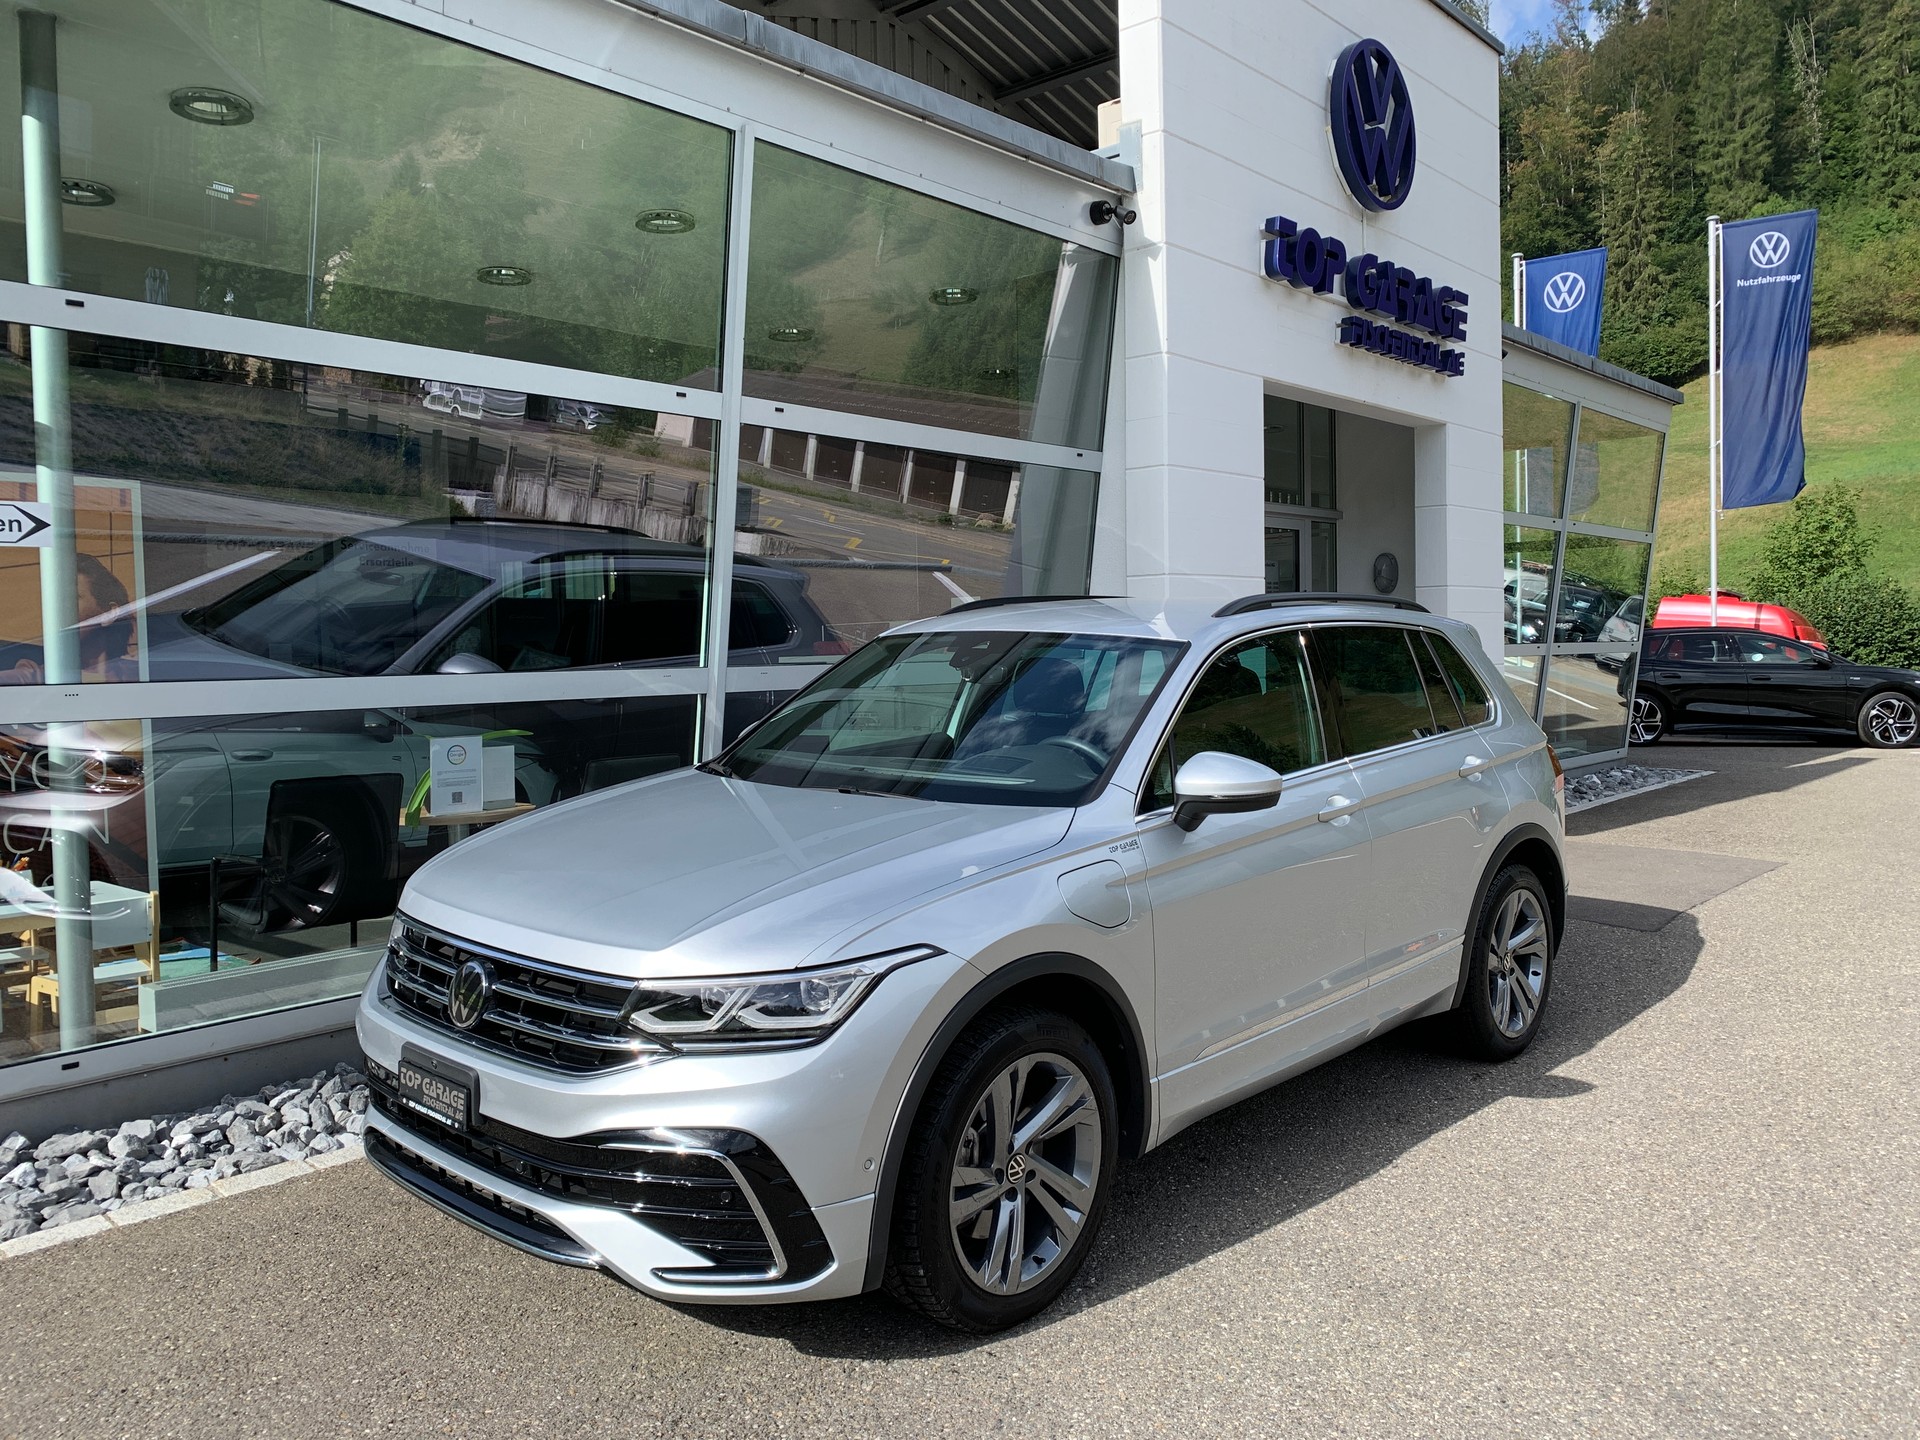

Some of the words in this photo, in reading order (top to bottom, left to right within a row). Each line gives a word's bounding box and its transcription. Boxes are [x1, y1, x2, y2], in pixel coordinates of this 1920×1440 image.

[1264, 215, 1347, 295] TOP
[1345, 253, 1469, 343] GARAGE
[1736, 273, 1802, 288] Nutzfahrzeuge
[1340, 315, 1443, 371] FISCHENTHAL
[340, 539, 430, 554] Serviceannahme
[359, 555, 414, 568] Ersatzteile
[400, 1066, 422, 1090] TOP
[422, 1077, 465, 1111] GARAGE
